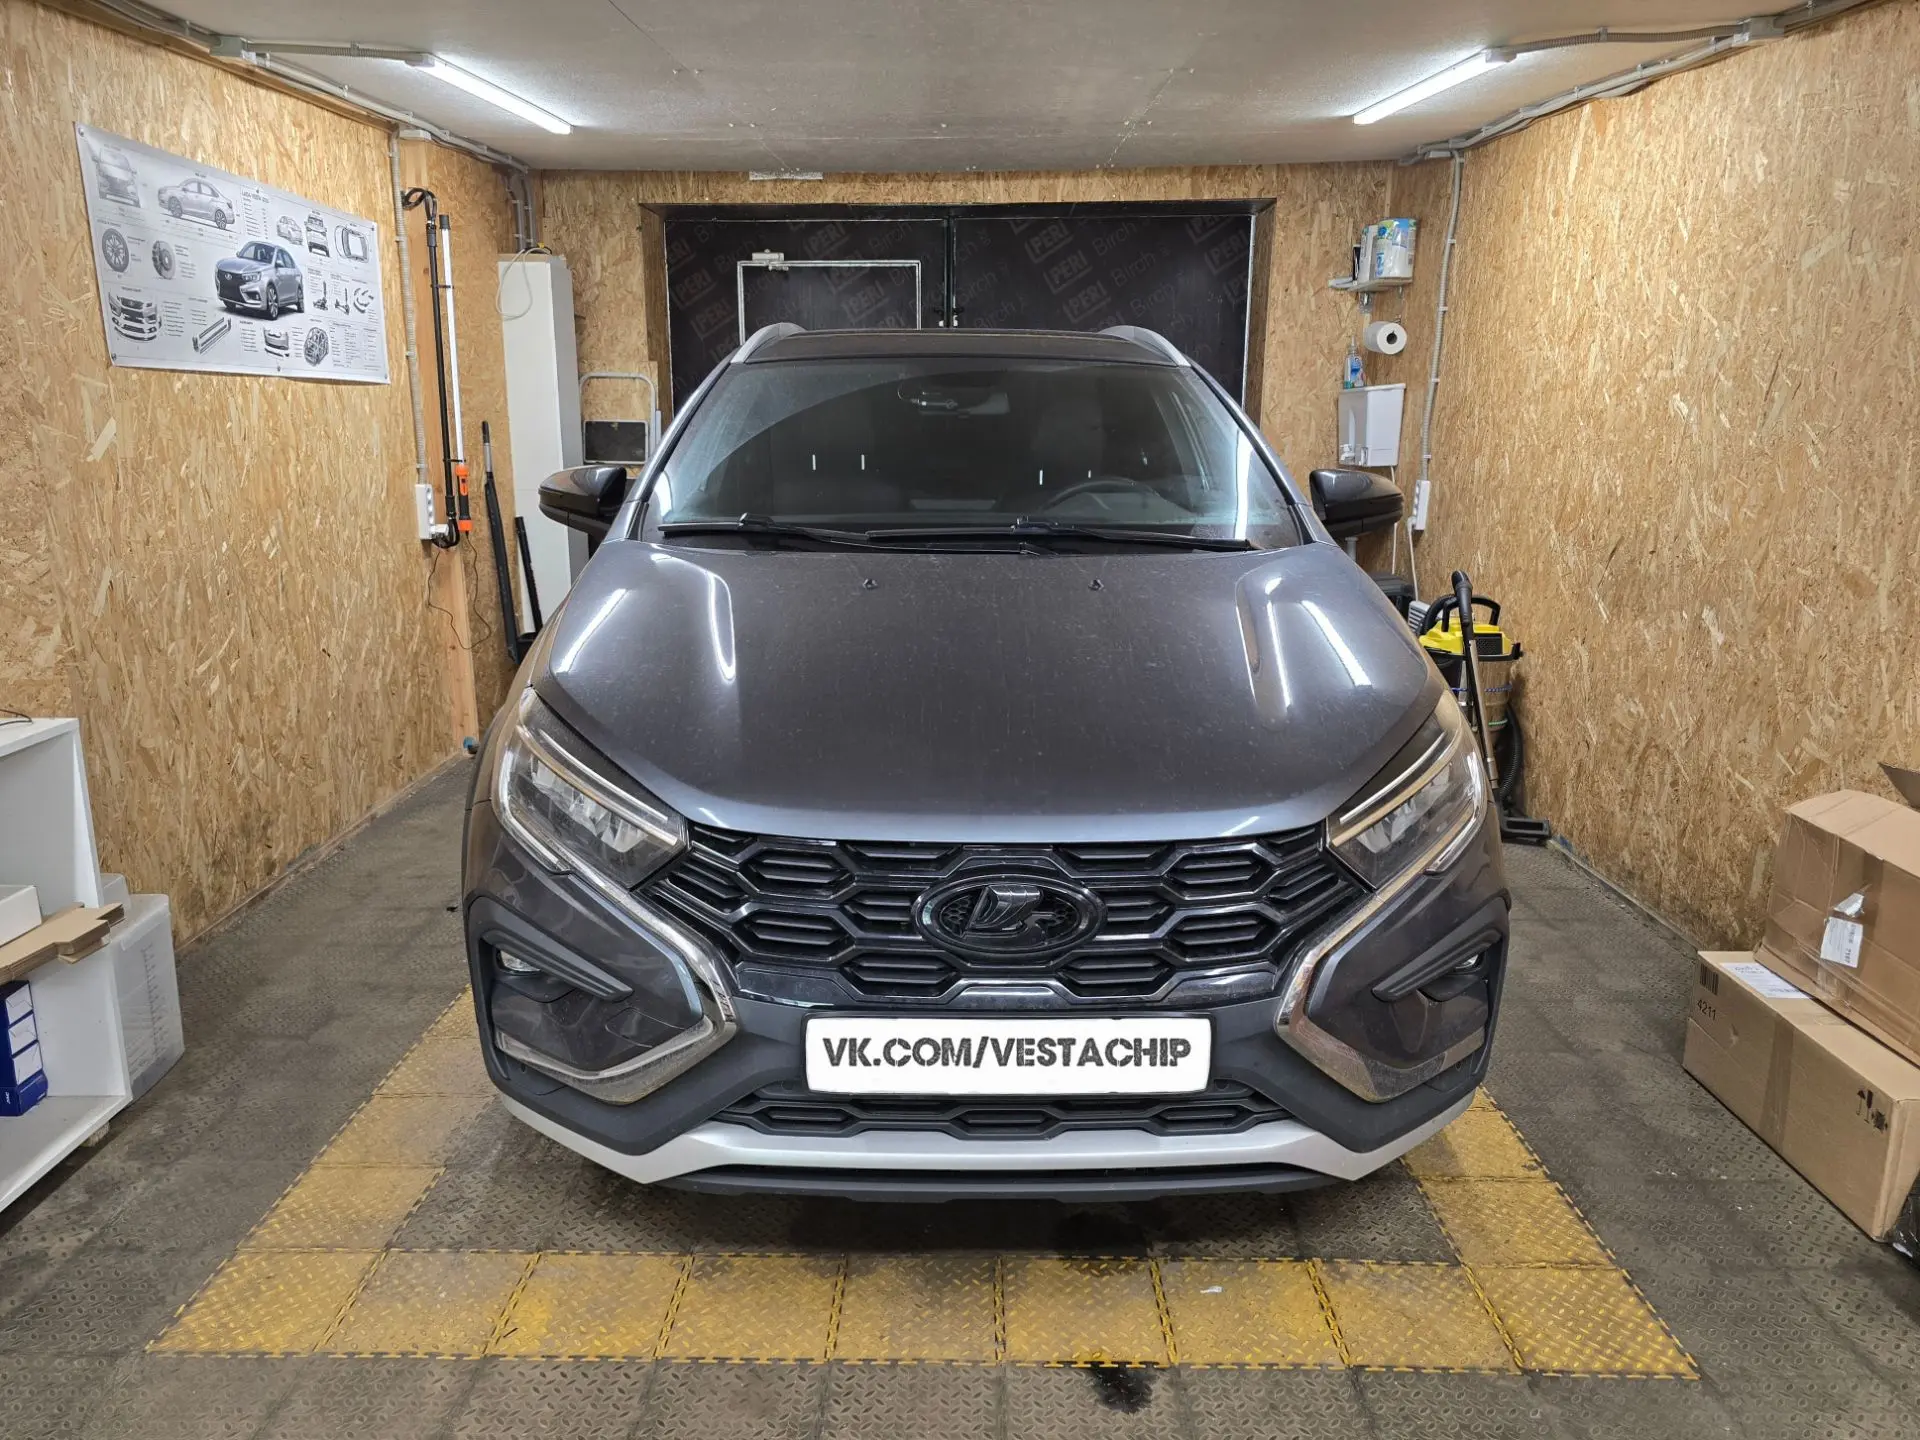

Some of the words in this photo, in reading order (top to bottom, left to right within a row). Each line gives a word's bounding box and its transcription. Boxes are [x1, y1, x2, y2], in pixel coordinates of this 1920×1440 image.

[1029, 219, 1070, 255] PERI
[1048, 249, 1088, 285] PERI
[1091, 221, 1138, 256] Birch
[675, 267, 713, 304] PERI
[847, 279, 885, 315] PERI
[1068, 279, 1108, 317] PERI
[1110, 250, 1156, 287] Birch
[1697, 999, 1718, 1021] 4211
